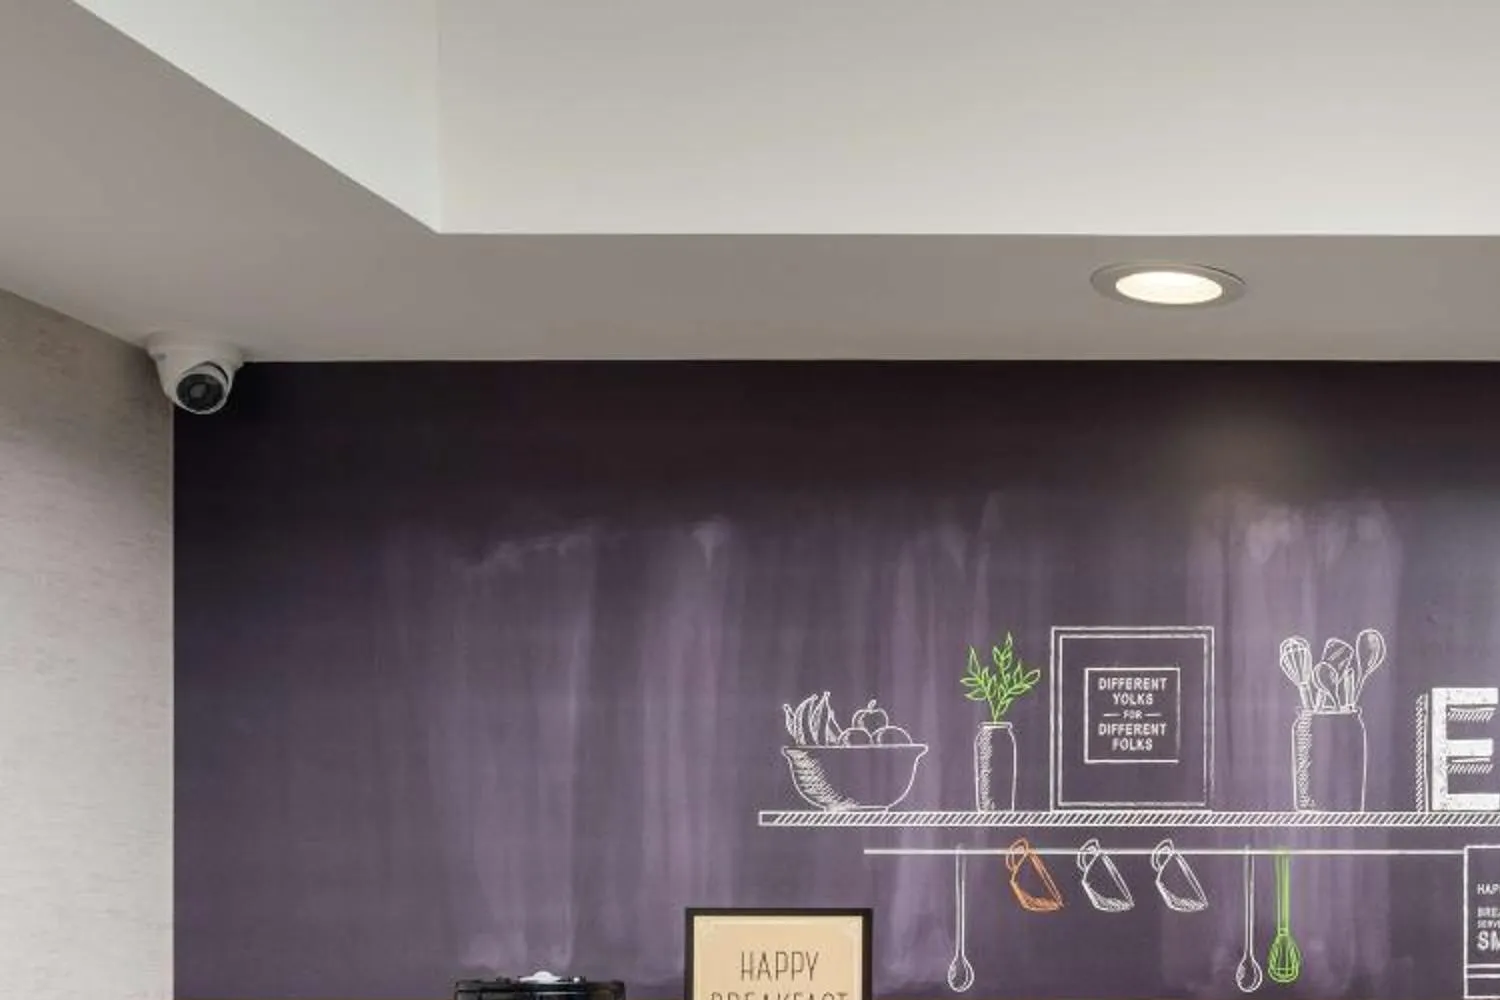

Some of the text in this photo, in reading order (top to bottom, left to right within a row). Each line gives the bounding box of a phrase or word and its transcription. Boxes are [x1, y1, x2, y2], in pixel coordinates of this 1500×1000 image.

[1098, 677, 1168, 691] DIFFERENT
[1112, 693, 1154, 705] YOLKS
[1123, 710, 1143, 719] FOR
[1098, 723, 1168, 736] DIFFERENT
[1112, 738, 1153, 751] FOLKS
[740, 950, 820, 981] HAPPY
